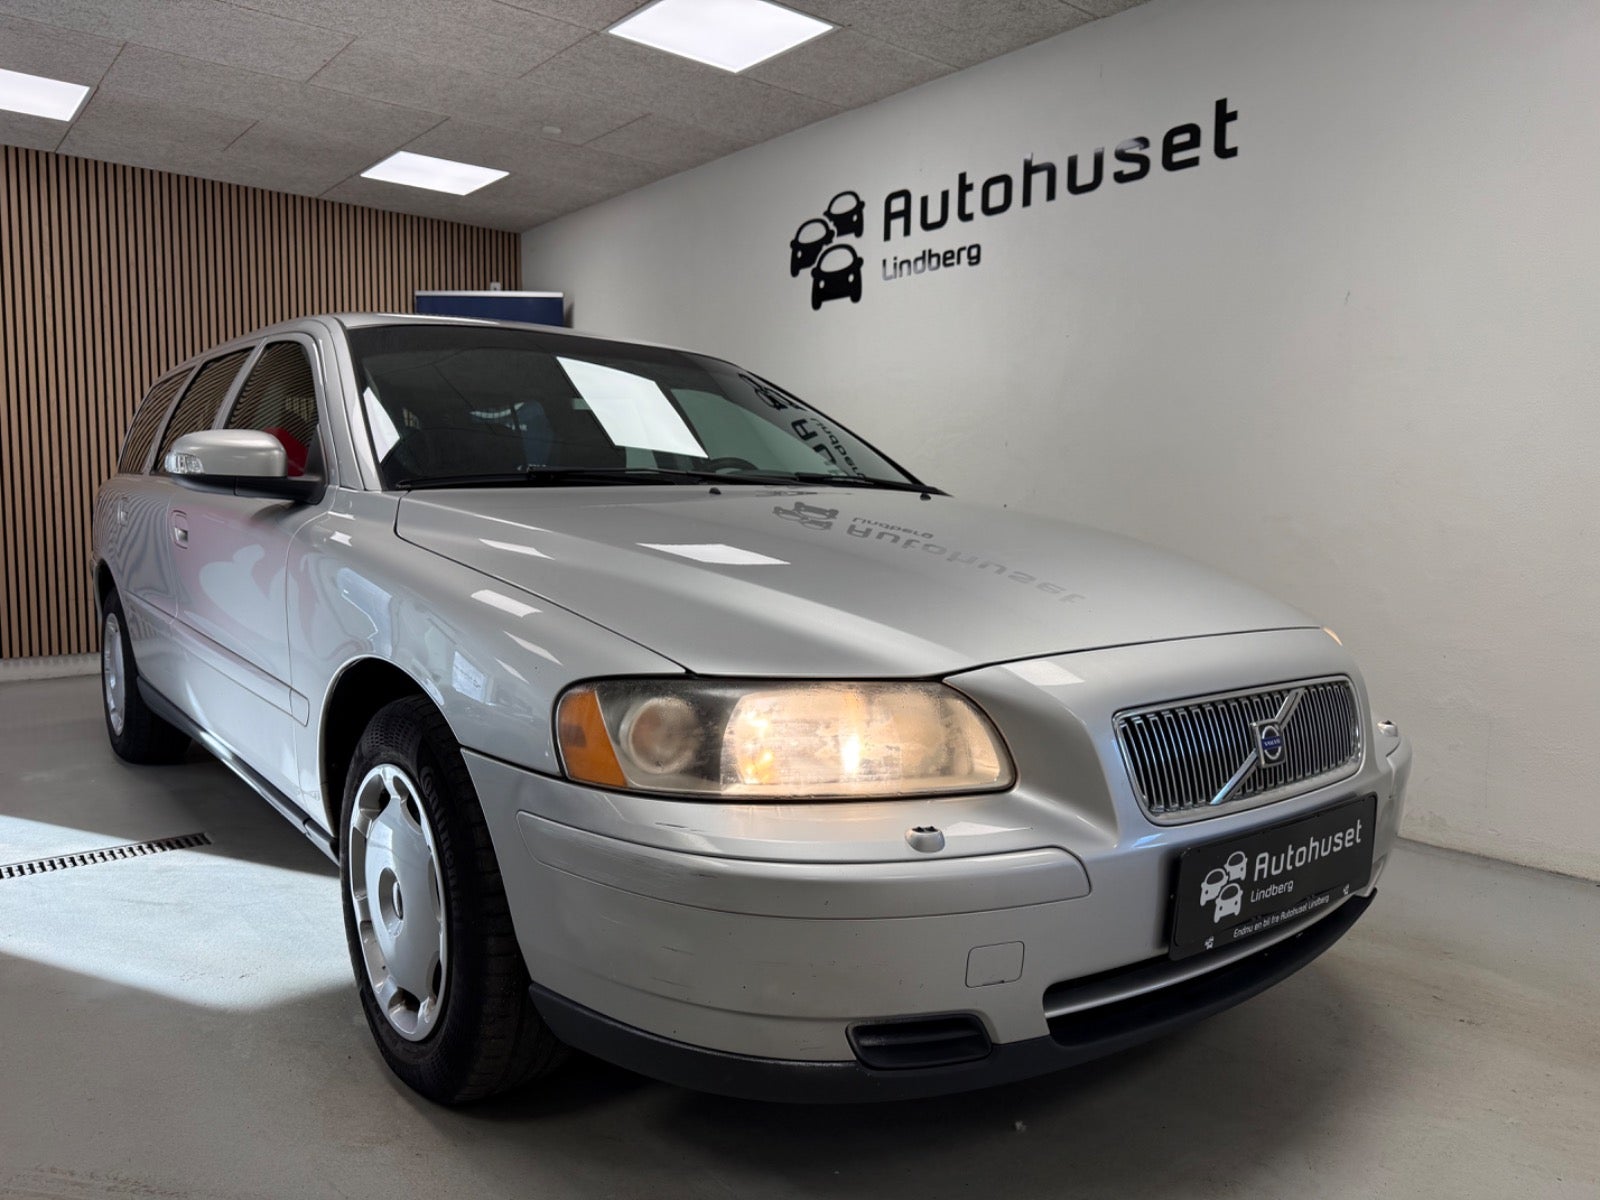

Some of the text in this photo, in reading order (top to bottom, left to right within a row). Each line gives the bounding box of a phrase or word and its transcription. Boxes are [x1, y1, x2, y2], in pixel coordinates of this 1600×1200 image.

[883, 97, 1239, 242] Autohuset
[882, 243, 982, 281] Lindberg
[1253, 819, 1362, 882] Autohuset
[1250, 879, 1294, 903] Lindberg
[1254, 921, 1263, 931] en
[1280, 902, 1307, 921] Autohuset
[1308, 894, 1330, 910] Lindberg
